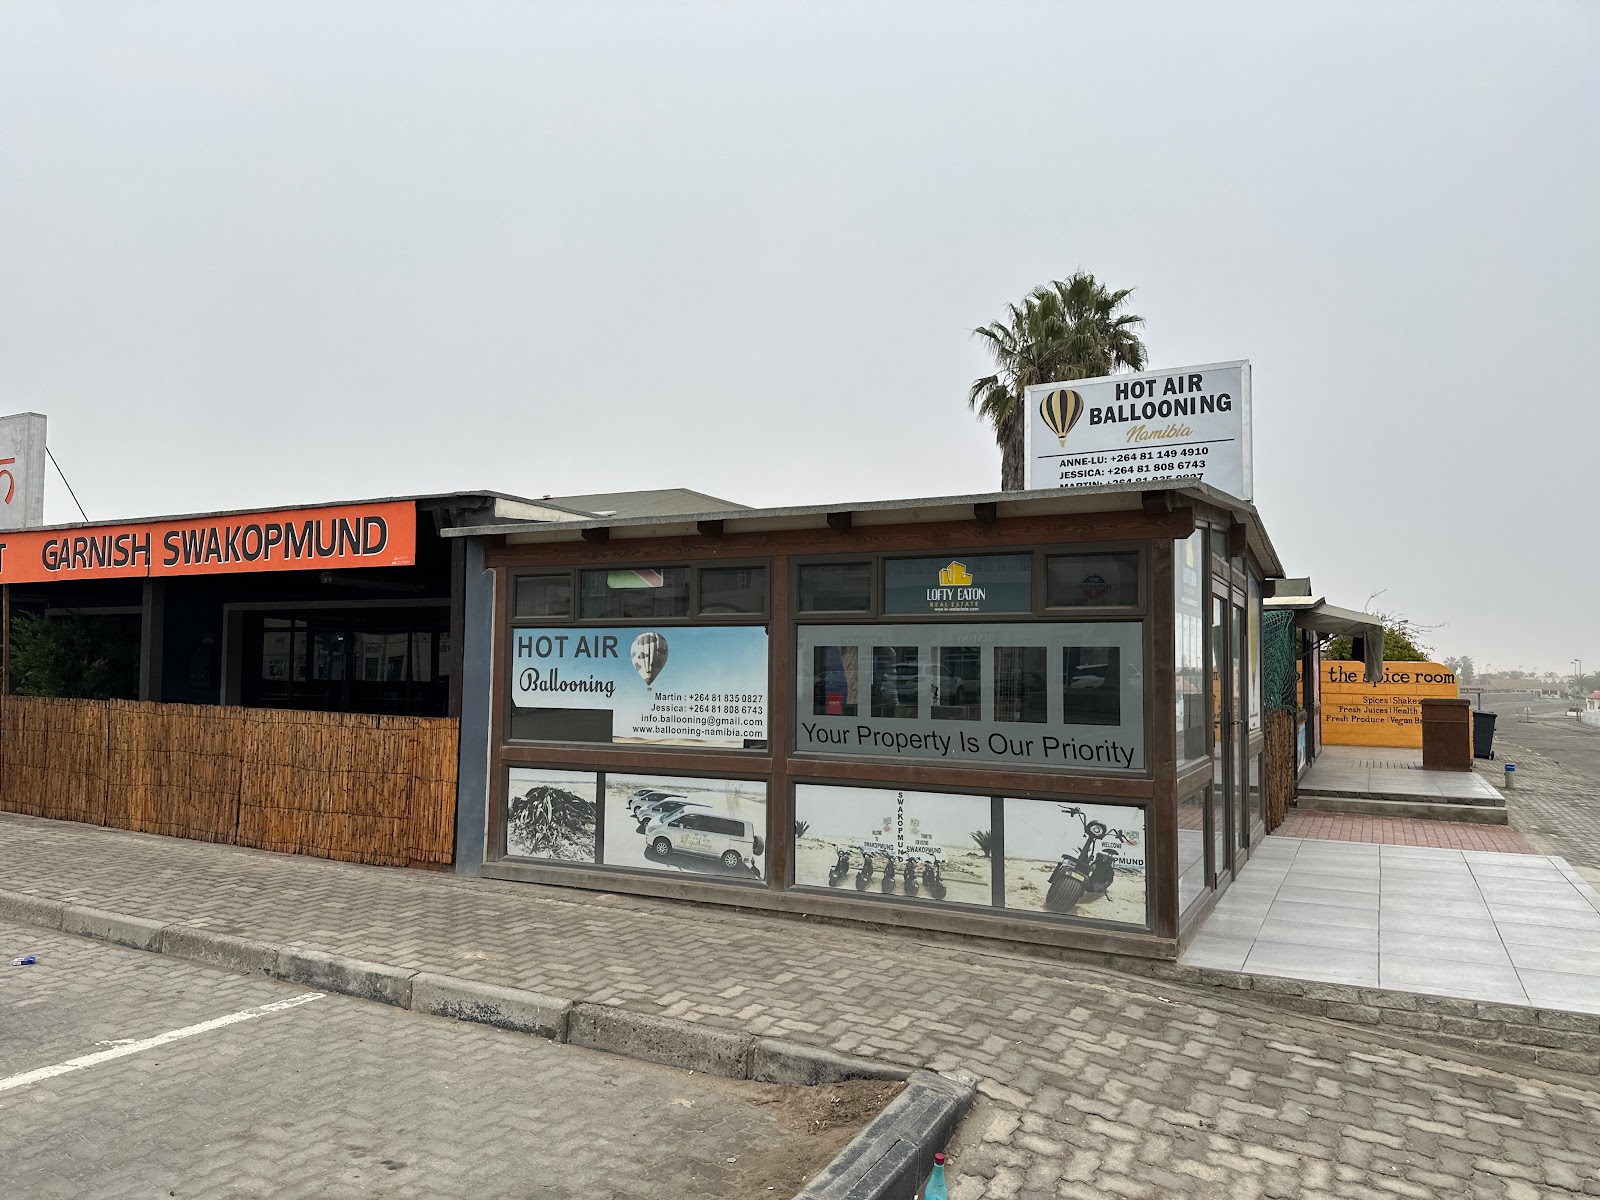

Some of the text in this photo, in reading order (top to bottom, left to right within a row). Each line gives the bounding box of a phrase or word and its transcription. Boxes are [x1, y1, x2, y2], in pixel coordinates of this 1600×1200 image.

[1115, 373, 1203, 401] HOT AIR
[1089, 393, 1232, 426] BALLOONING
[1126, 423, 1193, 443] Namibia
[1059, 446, 1208, 468] ANNE-LU: +264 81 149 4910
[1059, 460, 1206, 480] JESSICA: +264 81 808 6743
[41, 532, 152, 571] GARNISH
[163, 515, 389, 568] SWAKOPMUND
[927, 587, 986, 601] LOFTY EATON
[518, 635, 619, 658] HOT AIR
[519, 667, 616, 698] Ballooning
[1328, 666, 1358, 682] the
[1414, 672, 1455, 684] room
[654, 692, 682, 701] Martin
[689, 693, 709, 702] +264
[711, 693, 721, 702] 81
[723, 694, 740, 703] 835
[741, 694, 763, 703] 0827
[1362, 696, 1421, 705] Spices Shakes
[651, 703, 763, 715] Jessica: +264 81 808 6743
[1338, 705, 1361, 713] Fresh
[1363, 706, 1388, 714] Juices
[1393, 706, 1418, 714] Health
[641, 713, 763, 727] info.ballooning@gmail.com
[1325, 714, 1349, 722] Fresh
[1351, 715, 1385, 723] Produce
[1390, 716, 1413, 726] Vegan
[632, 724, 763, 738] www.ballooning-namibia.com
[802, 722, 1135, 768] Your Property Is Our Priority
[906, 845, 942, 854] SWAKOPMUND
[1101, 841, 1123, 849] WELCOME
